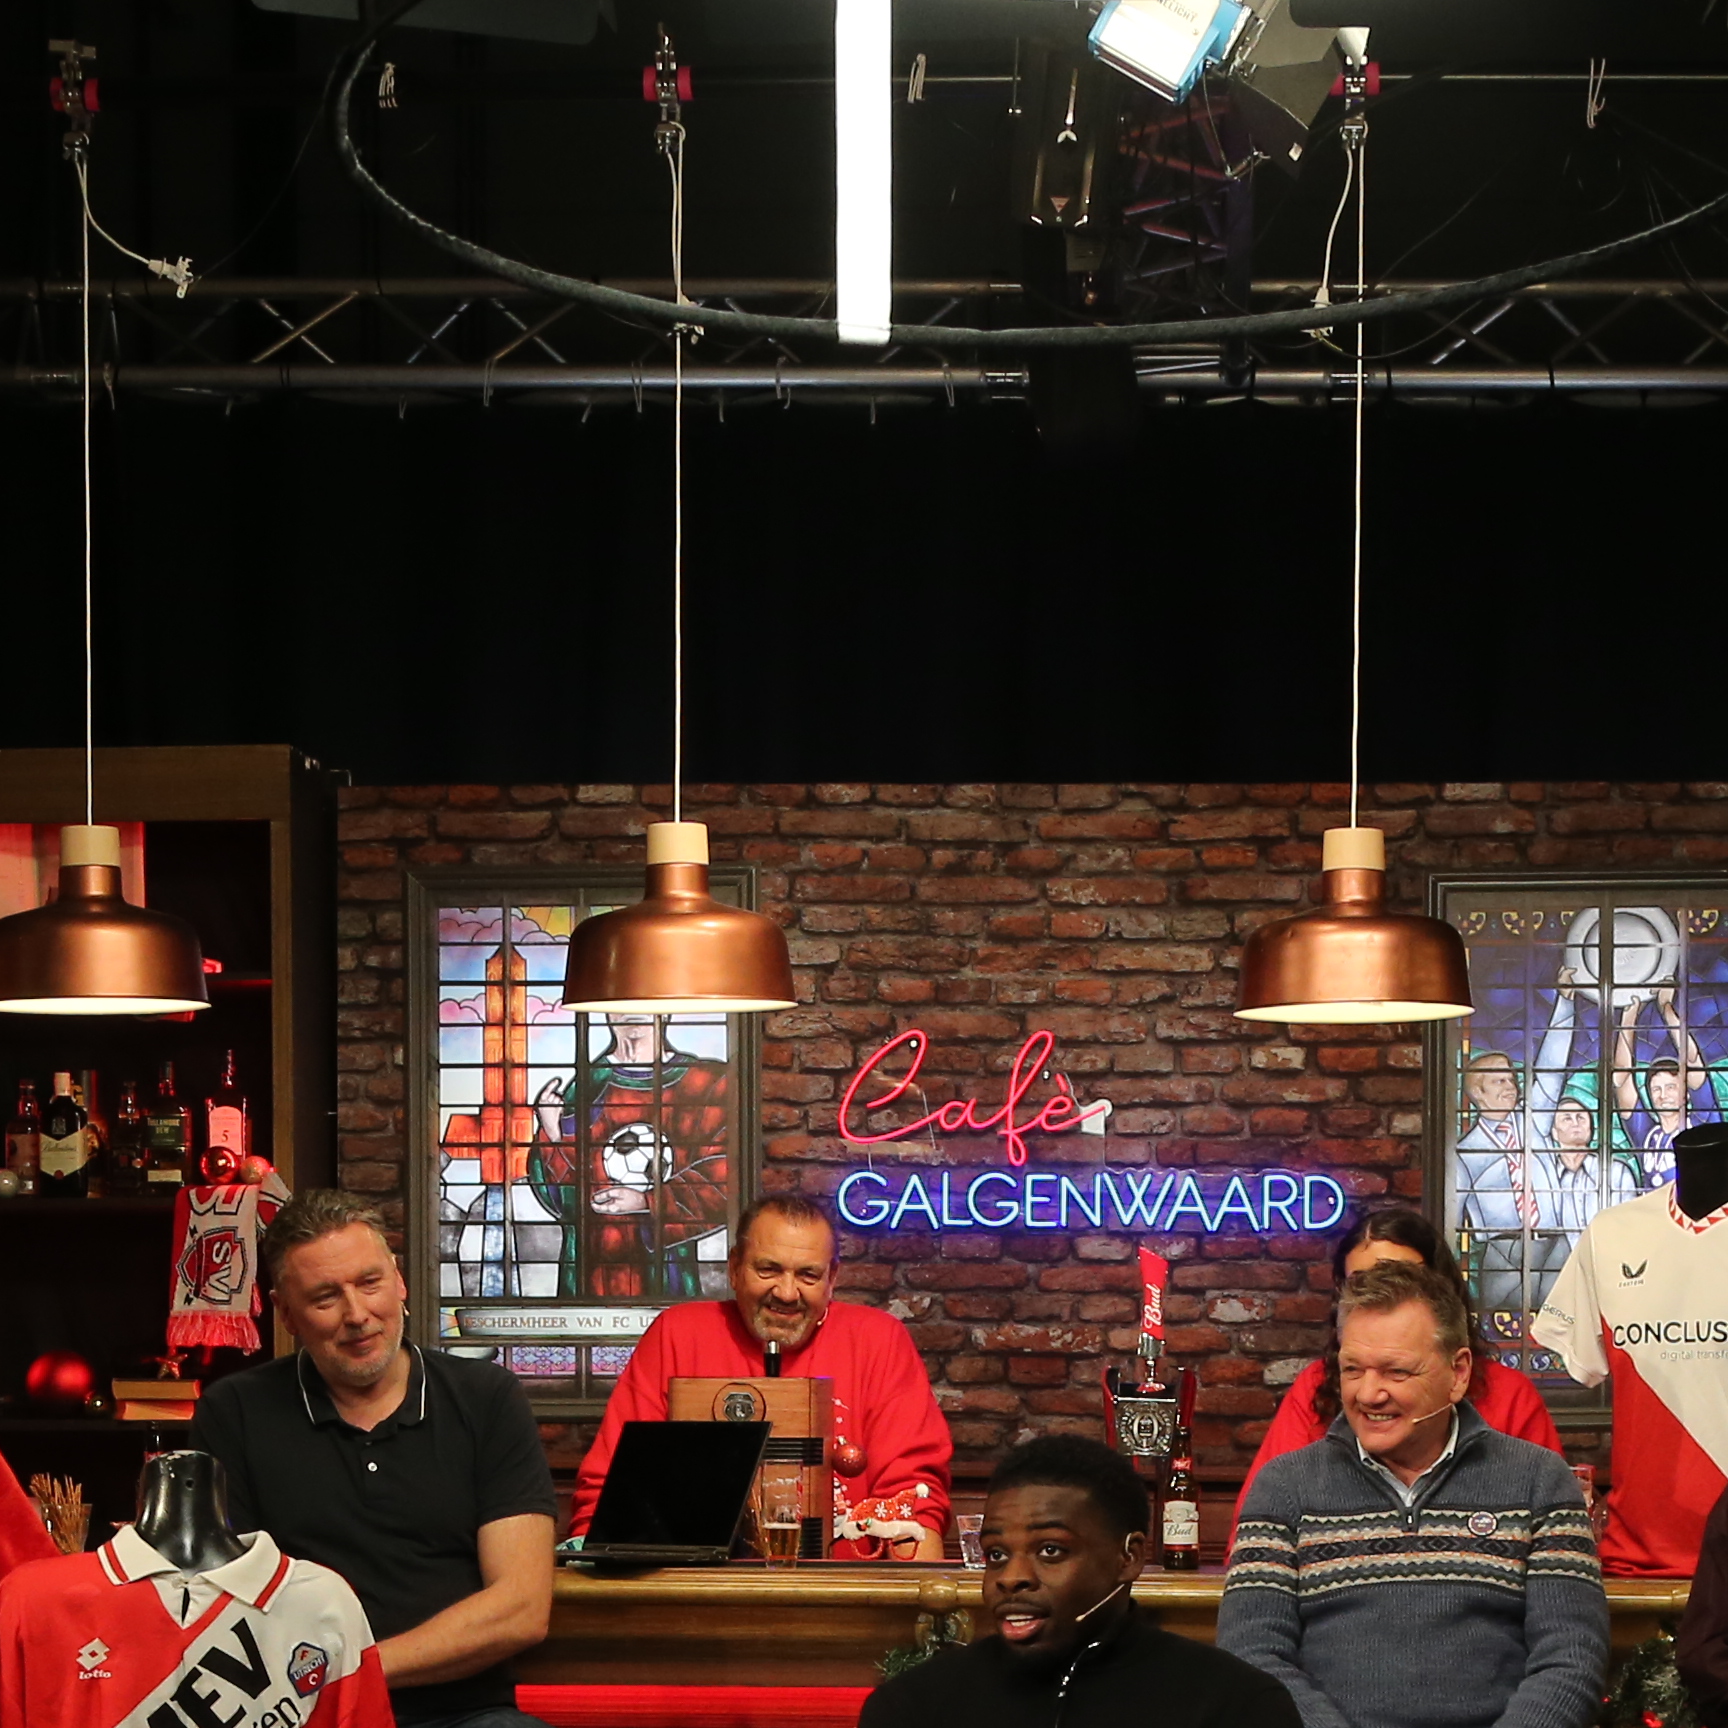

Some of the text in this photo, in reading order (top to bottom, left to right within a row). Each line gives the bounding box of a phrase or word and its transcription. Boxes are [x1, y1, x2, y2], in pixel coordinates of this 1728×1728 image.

[836, 1170, 1346, 1232] GALGENWAARD
[1143, 1283, 1162, 1330] Bud
[463, 1316, 568, 1329] BESCHERMHEER
[576, 1316, 604, 1328] VAN
[612, 1316, 630, 1329] FC
[1660, 1350, 1693, 1362] digital
[1165, 1521, 1193, 1537] Bud
[300, 1650, 309, 1661] F
[78, 1668, 112, 1680] lotto
[308, 1672, 319, 1686] C
